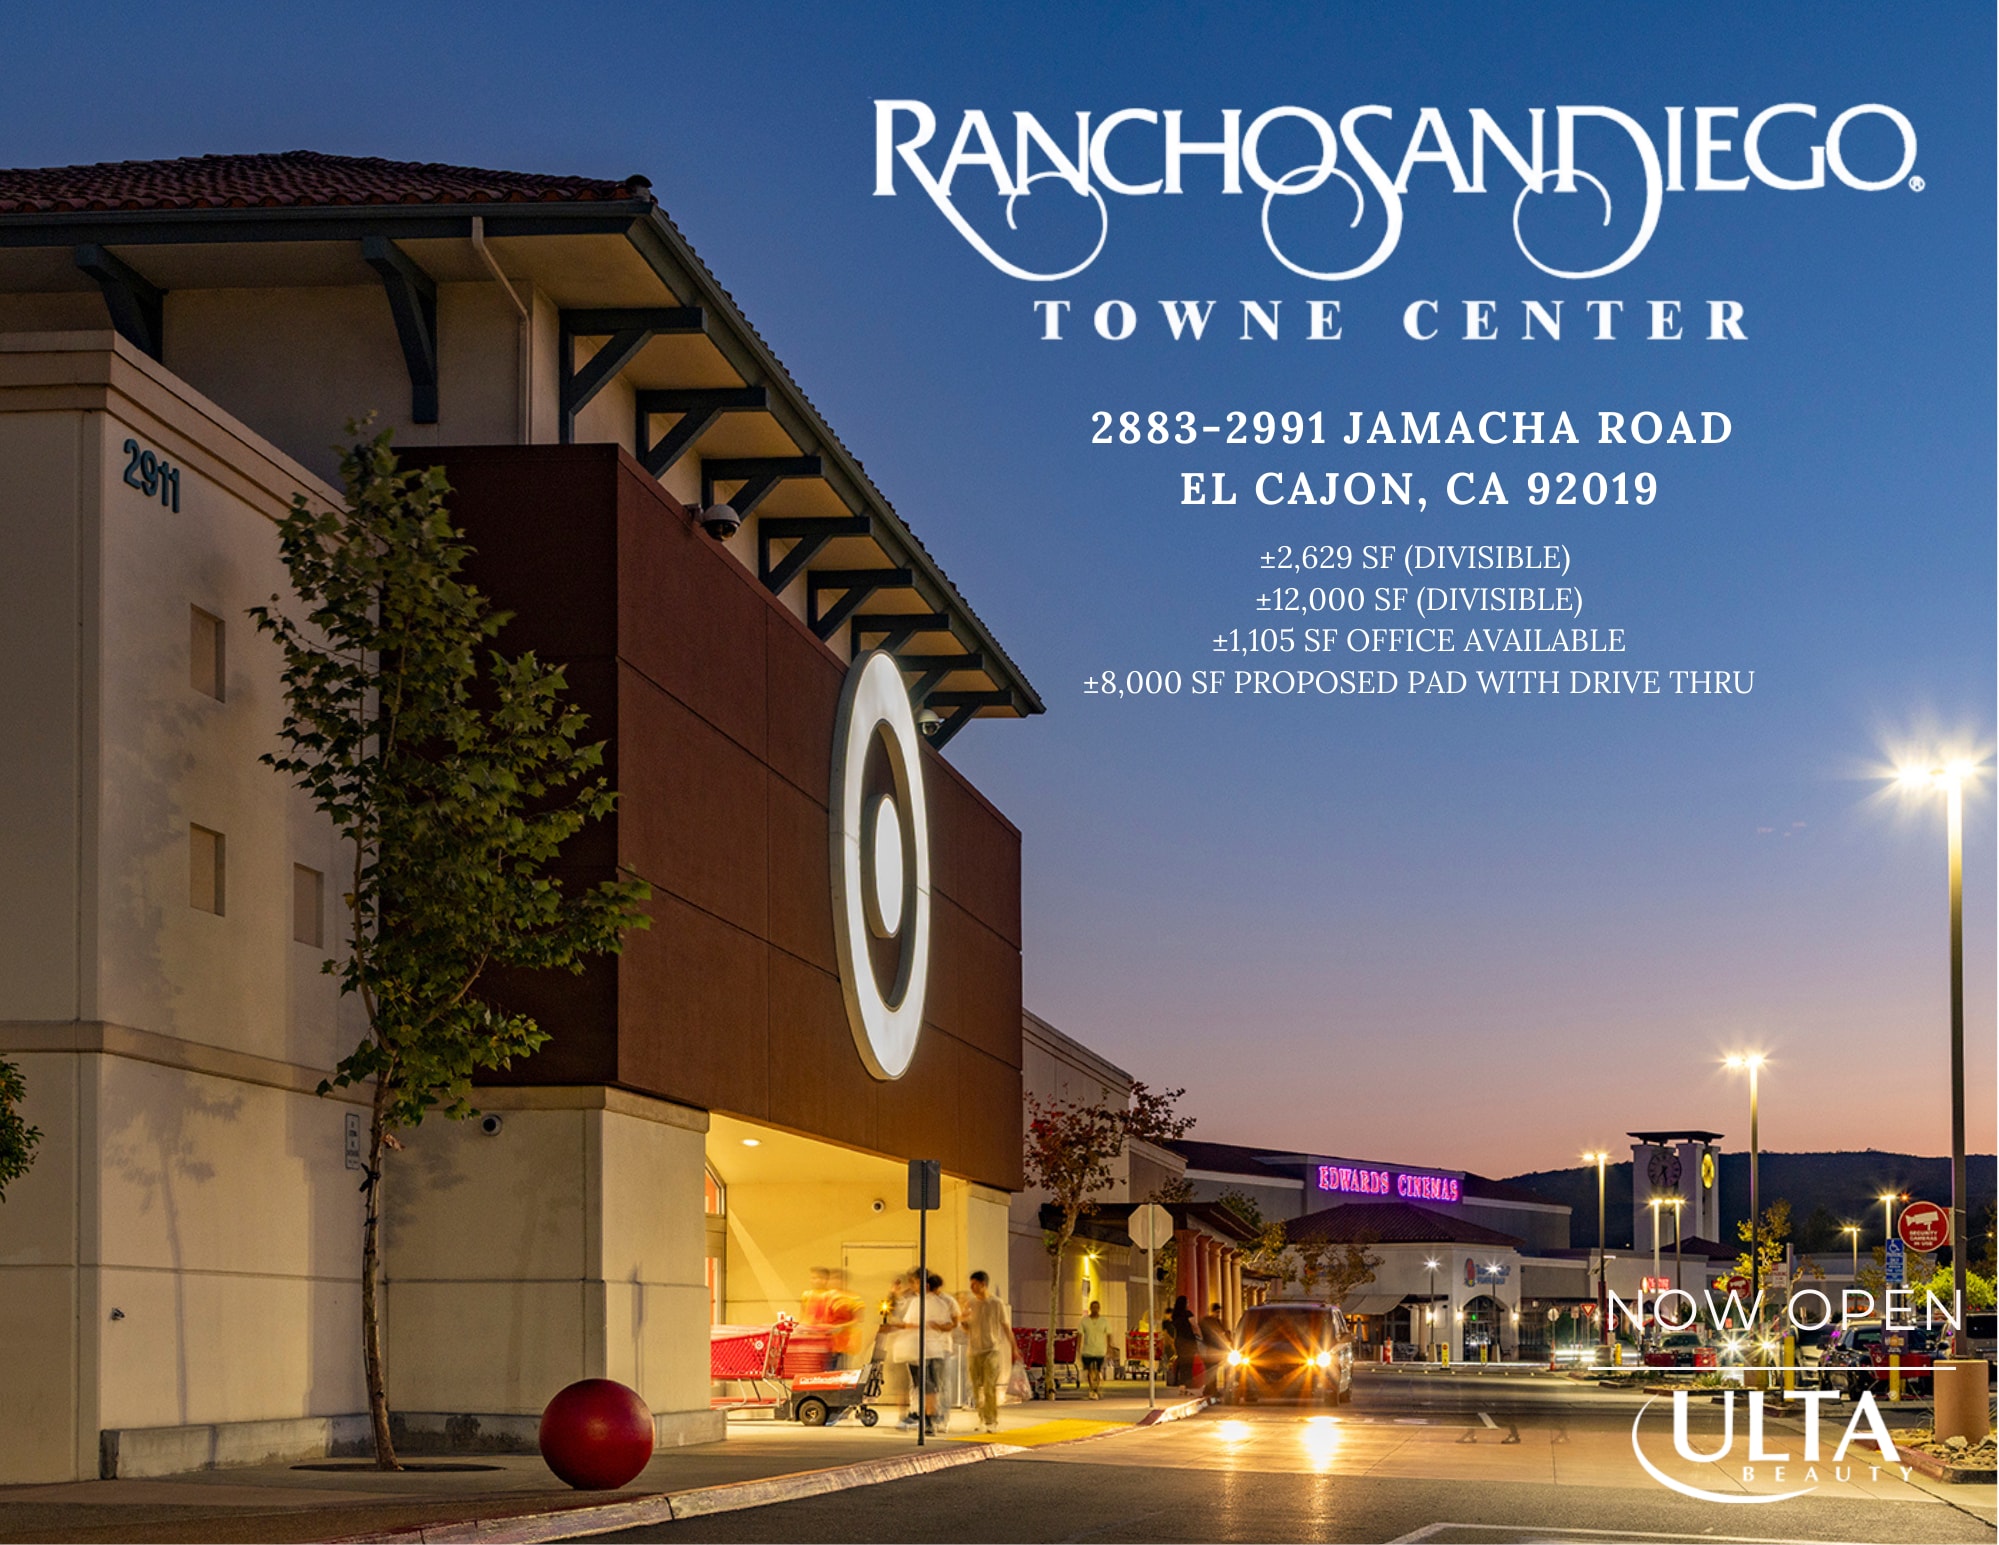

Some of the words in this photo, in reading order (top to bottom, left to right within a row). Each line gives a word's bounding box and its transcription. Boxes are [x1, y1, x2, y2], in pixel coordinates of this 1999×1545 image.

[123, 438, 180, 513] 2911
[1318, 1165, 1390, 1195] EDWARDS
[1397, 1174, 1459, 1202] CINEMAS
